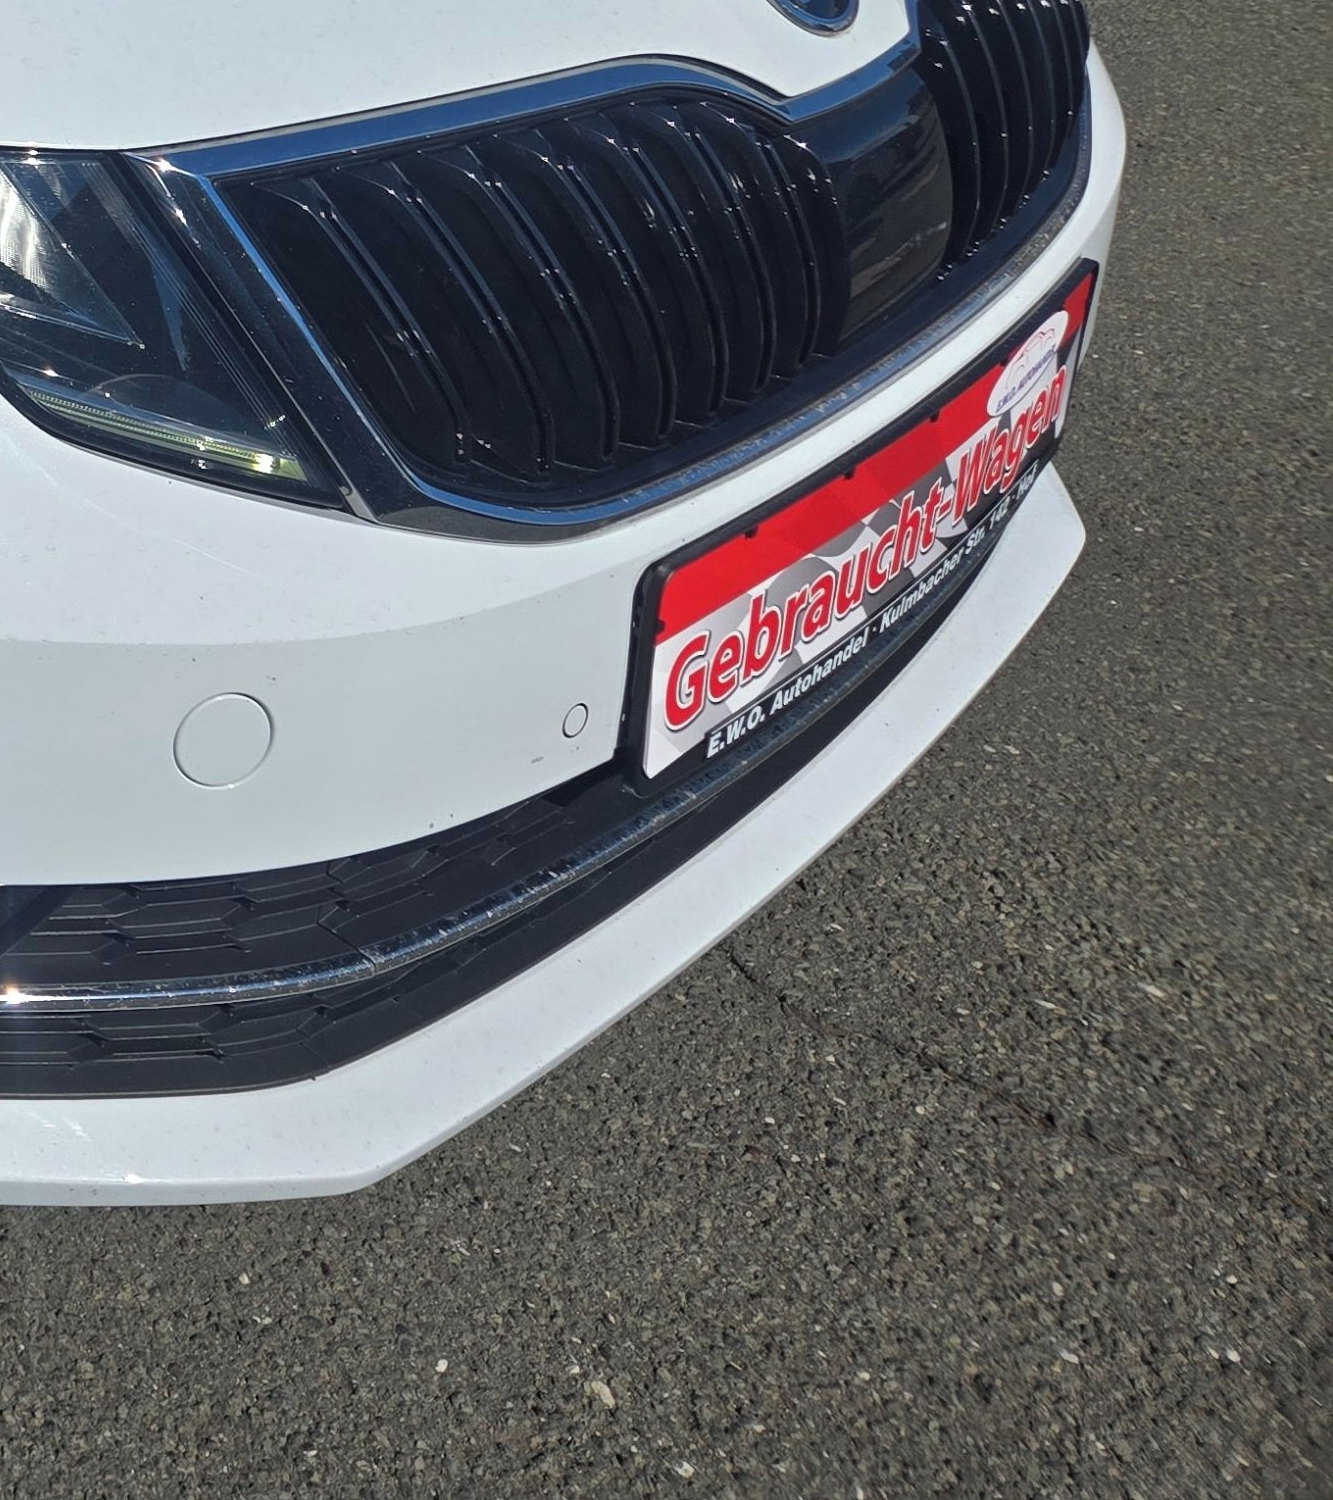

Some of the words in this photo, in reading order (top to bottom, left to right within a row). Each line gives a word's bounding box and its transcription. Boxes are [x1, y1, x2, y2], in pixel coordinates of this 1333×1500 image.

[664, 365, 1066, 732] Gebraucht-Wagen
[706, 705, 766, 759] E.W.O.
[769, 625, 870, 717] Autohandel
[879, 546, 965, 634] Kulmbacher
